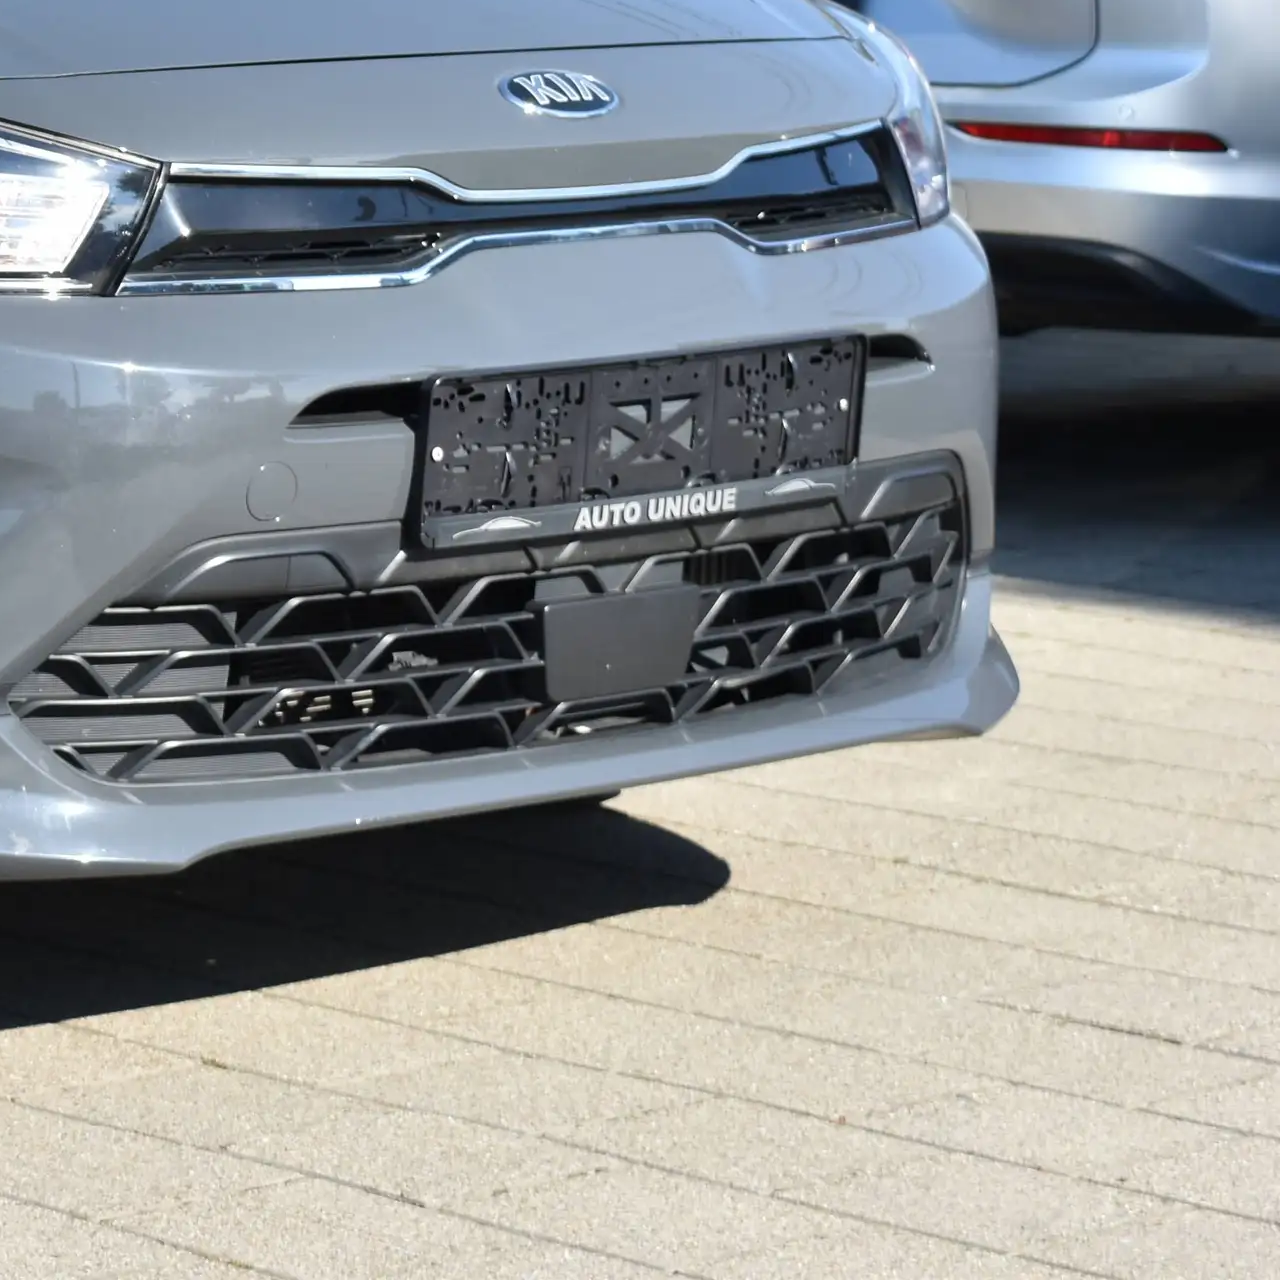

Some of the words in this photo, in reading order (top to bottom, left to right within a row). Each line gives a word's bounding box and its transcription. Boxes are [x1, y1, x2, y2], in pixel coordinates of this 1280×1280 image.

[513, 73, 610, 105] KIA
[573, 500, 641, 532] AUTO
[647, 487, 738, 521] UNIQUE
